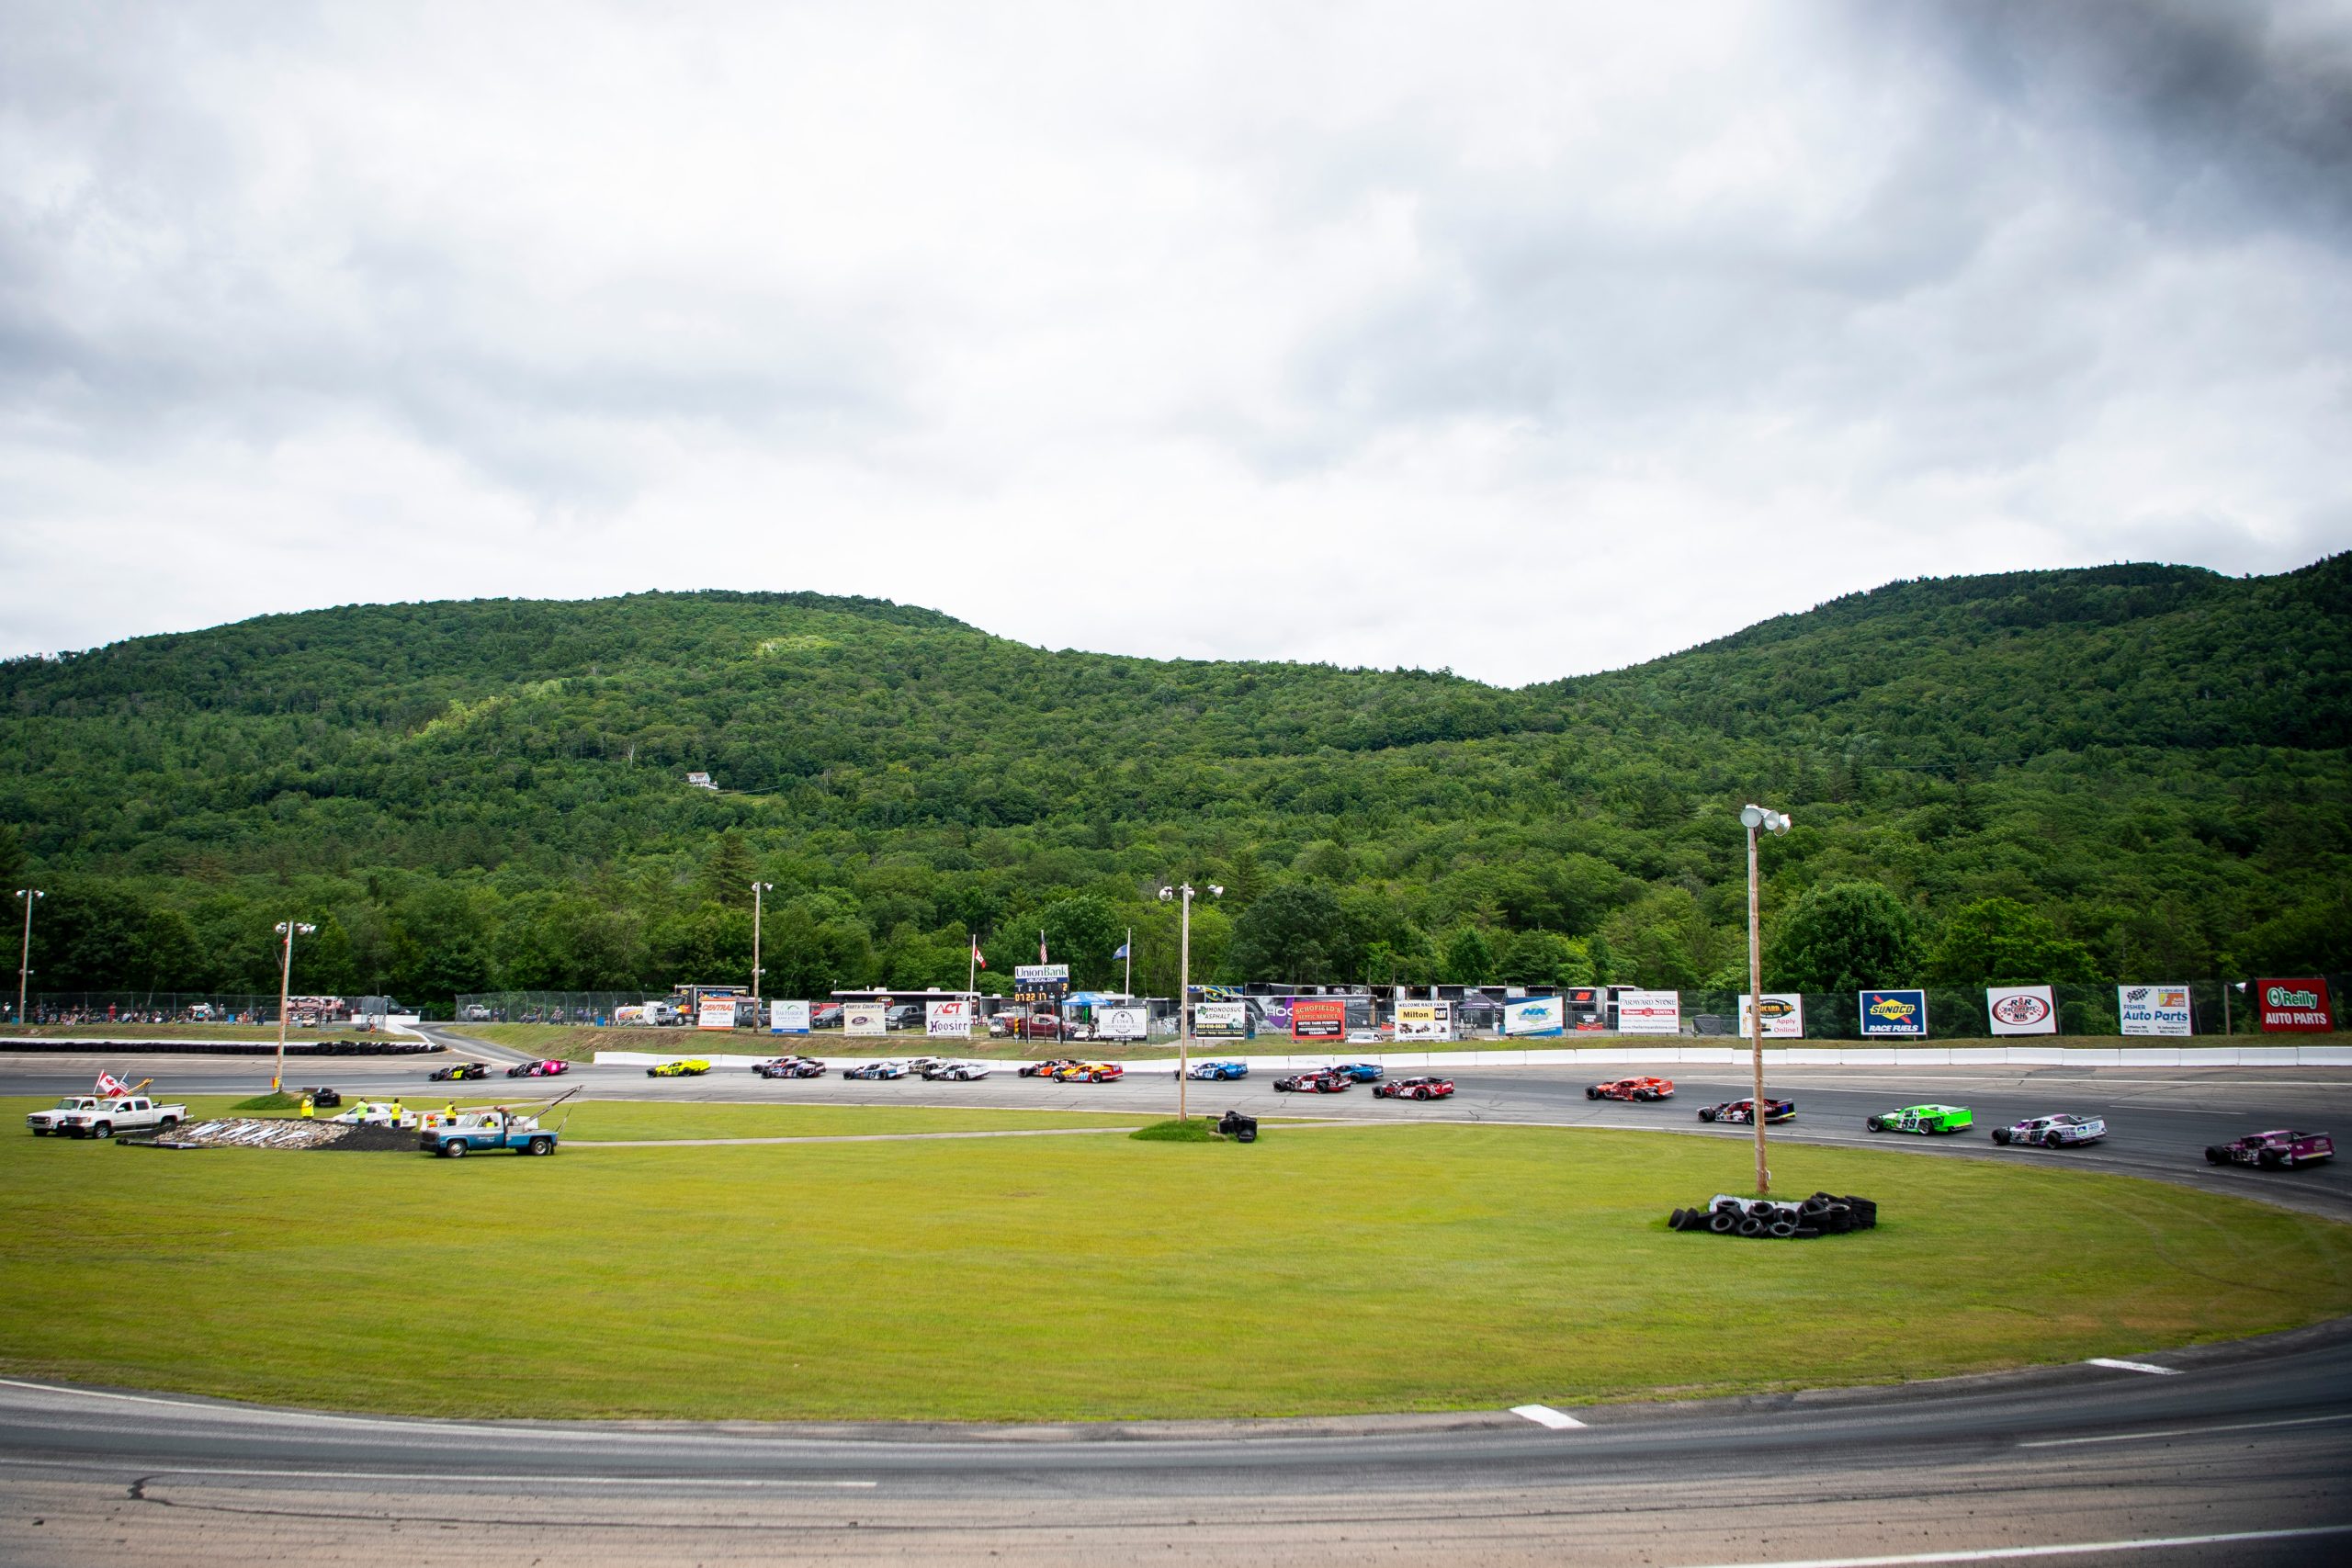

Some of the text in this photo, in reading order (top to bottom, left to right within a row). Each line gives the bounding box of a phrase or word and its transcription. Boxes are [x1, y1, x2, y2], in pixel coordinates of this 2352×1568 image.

[1016, 966, 1068, 976] UnionBank
[1025, 993, 1035, 1001] 22
[2267, 986, 2318, 1010] O'Reilly
[702, 1003, 735, 1011] CENTRAL
[933, 1003, 962, 1014] ACT
[1295, 1005, 1341, 1015] SCHOFIELD'S
[1871, 1005, 1914, 1014] SUNOCO
[1435, 1010, 1447, 1019] CAT
[2123, 1010, 2188, 1021] Auto Parts
[2266, 1012, 2327, 1025] AUTO PARTS
[929, 1020, 967, 1032] Hoosier
[1868, 1024, 1919, 1032] RACE FUELS
